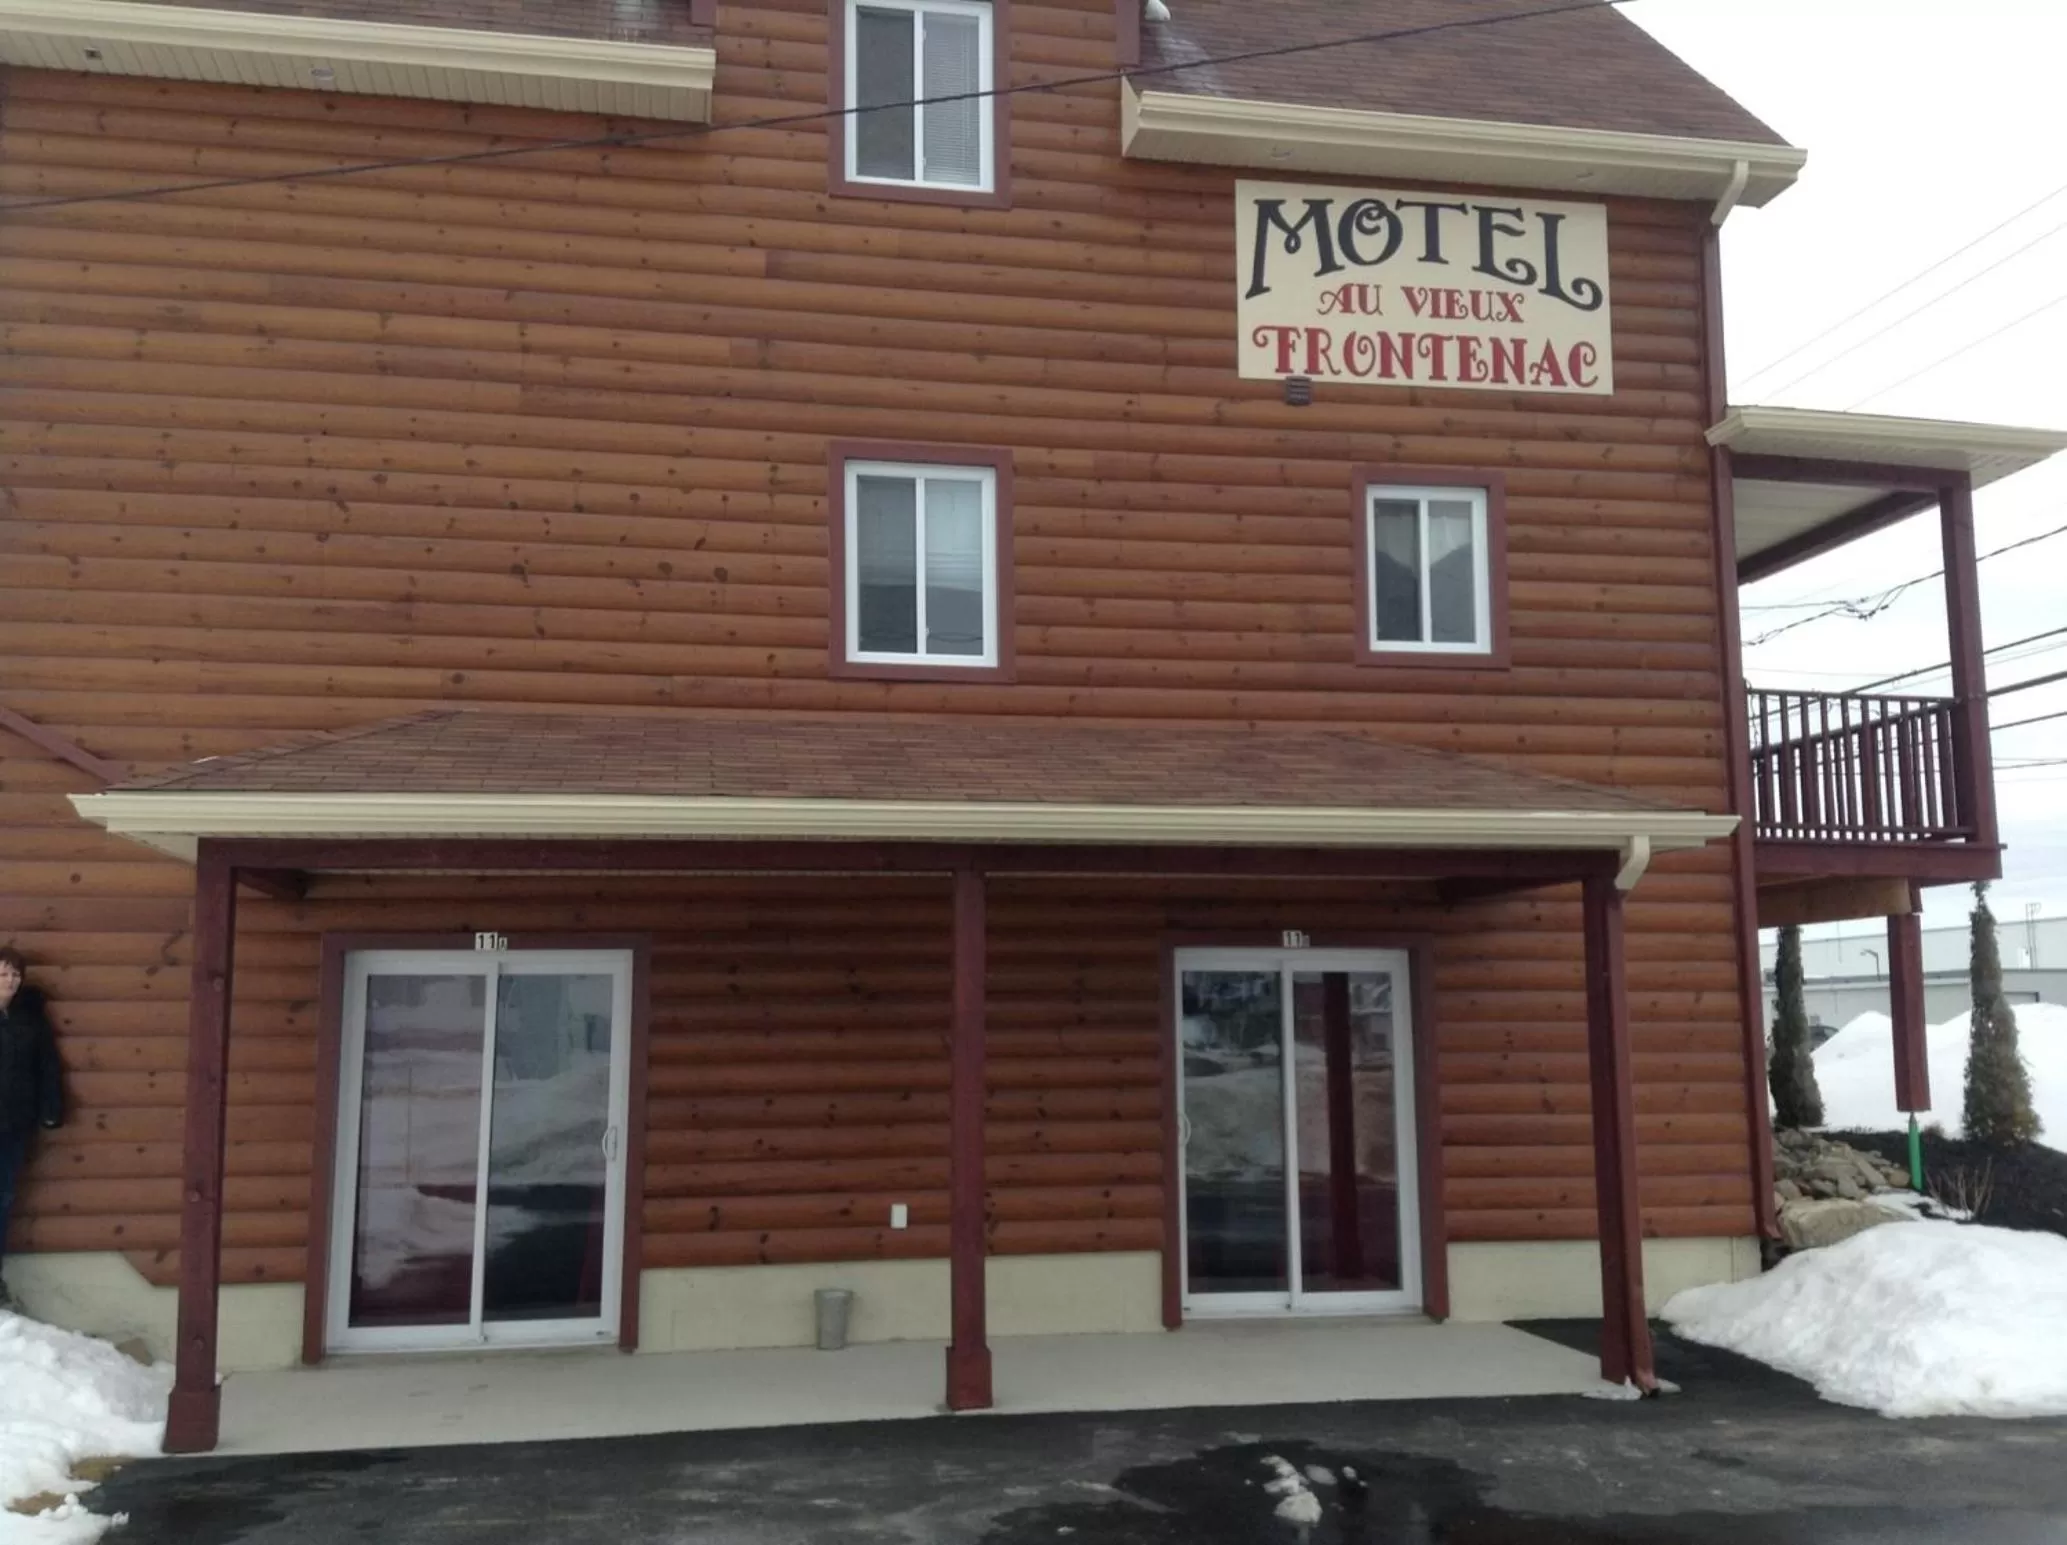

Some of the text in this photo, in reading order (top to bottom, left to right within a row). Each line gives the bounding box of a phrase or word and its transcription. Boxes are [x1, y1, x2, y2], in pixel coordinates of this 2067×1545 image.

[1245, 198, 1603, 311] MOTEL
[1317, 283, 1525, 323] AU VIEUX
[1252, 325, 1599, 388] FRONTENAC
